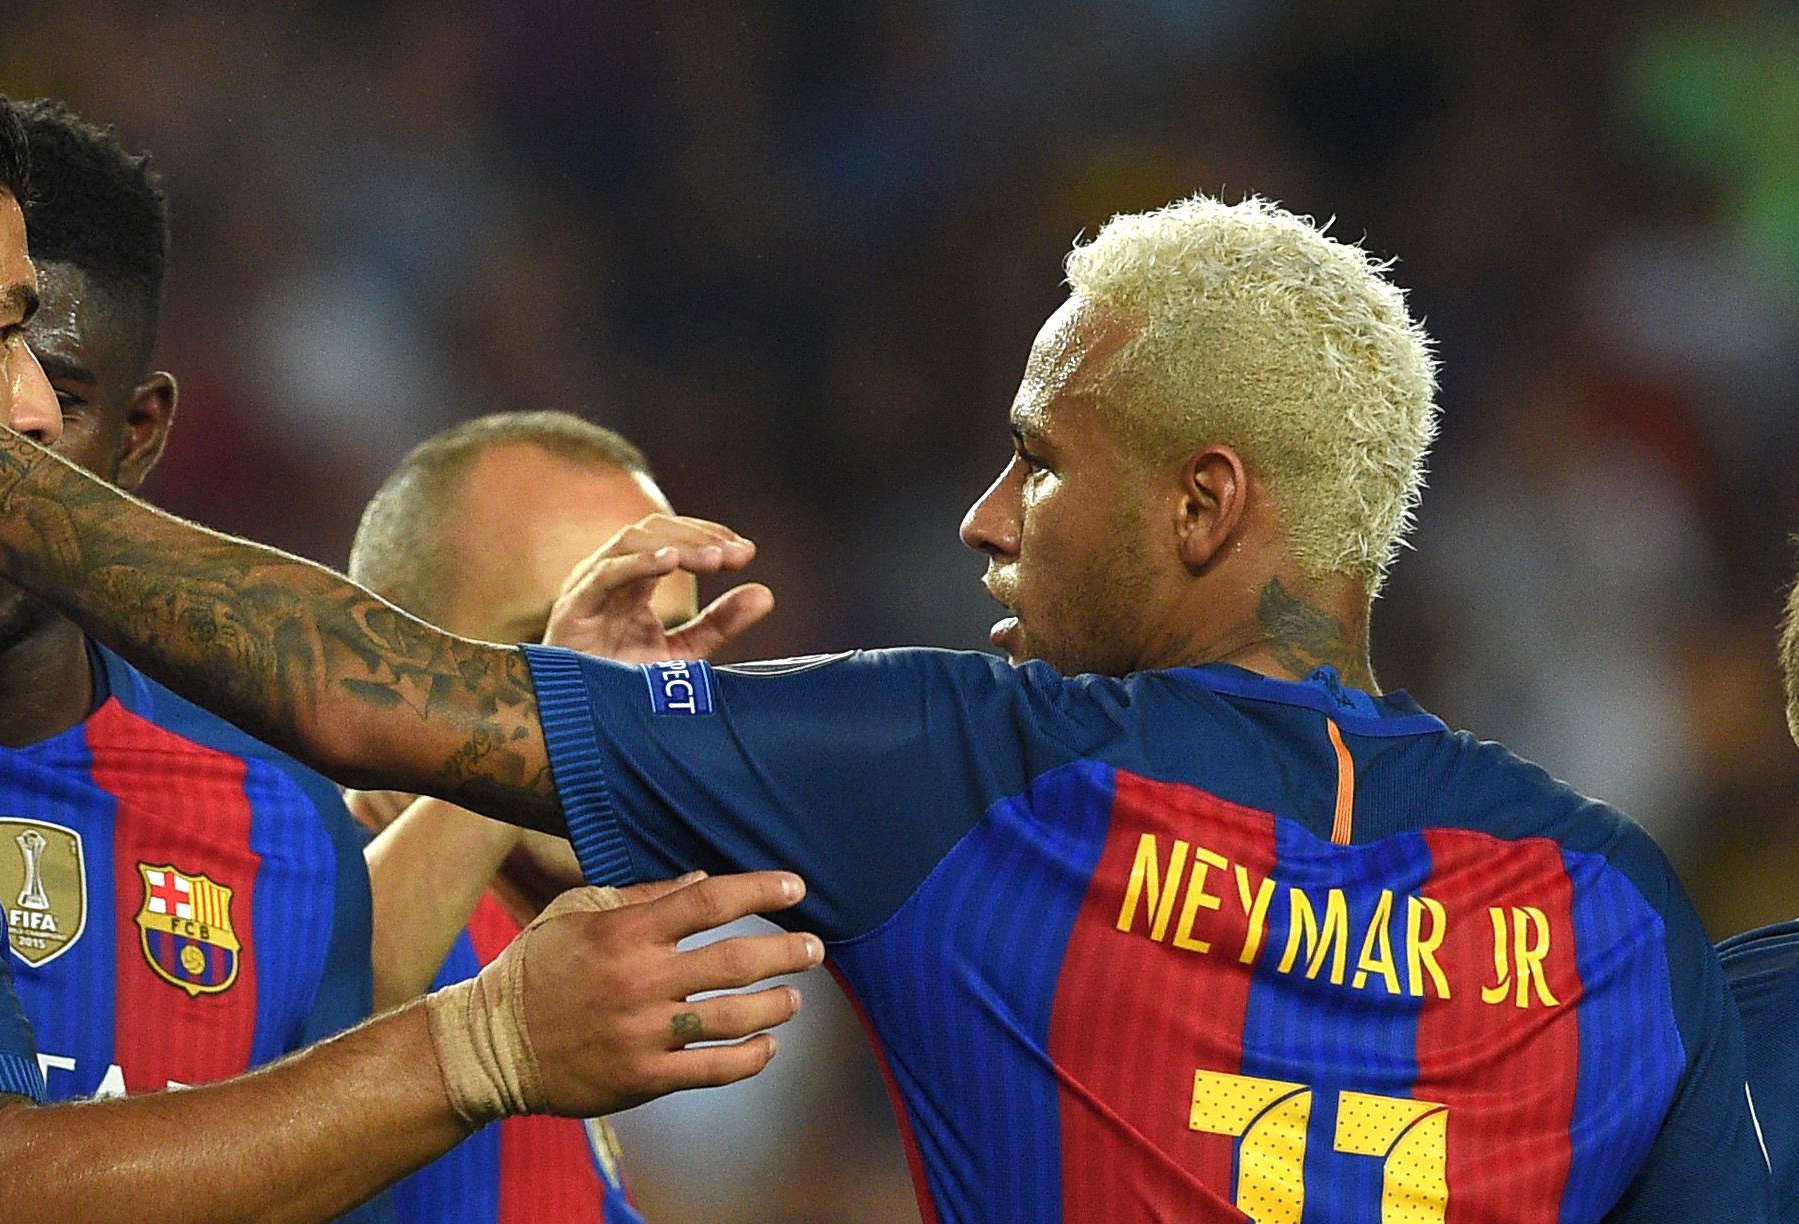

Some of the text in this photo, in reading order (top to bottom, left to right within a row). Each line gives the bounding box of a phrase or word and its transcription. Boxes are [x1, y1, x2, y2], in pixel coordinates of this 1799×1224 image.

[656, 659, 696, 714] PECT
[9, 909, 57, 932] FIFA
[1116, 833, 1561, 1009] NEYMAR JR
